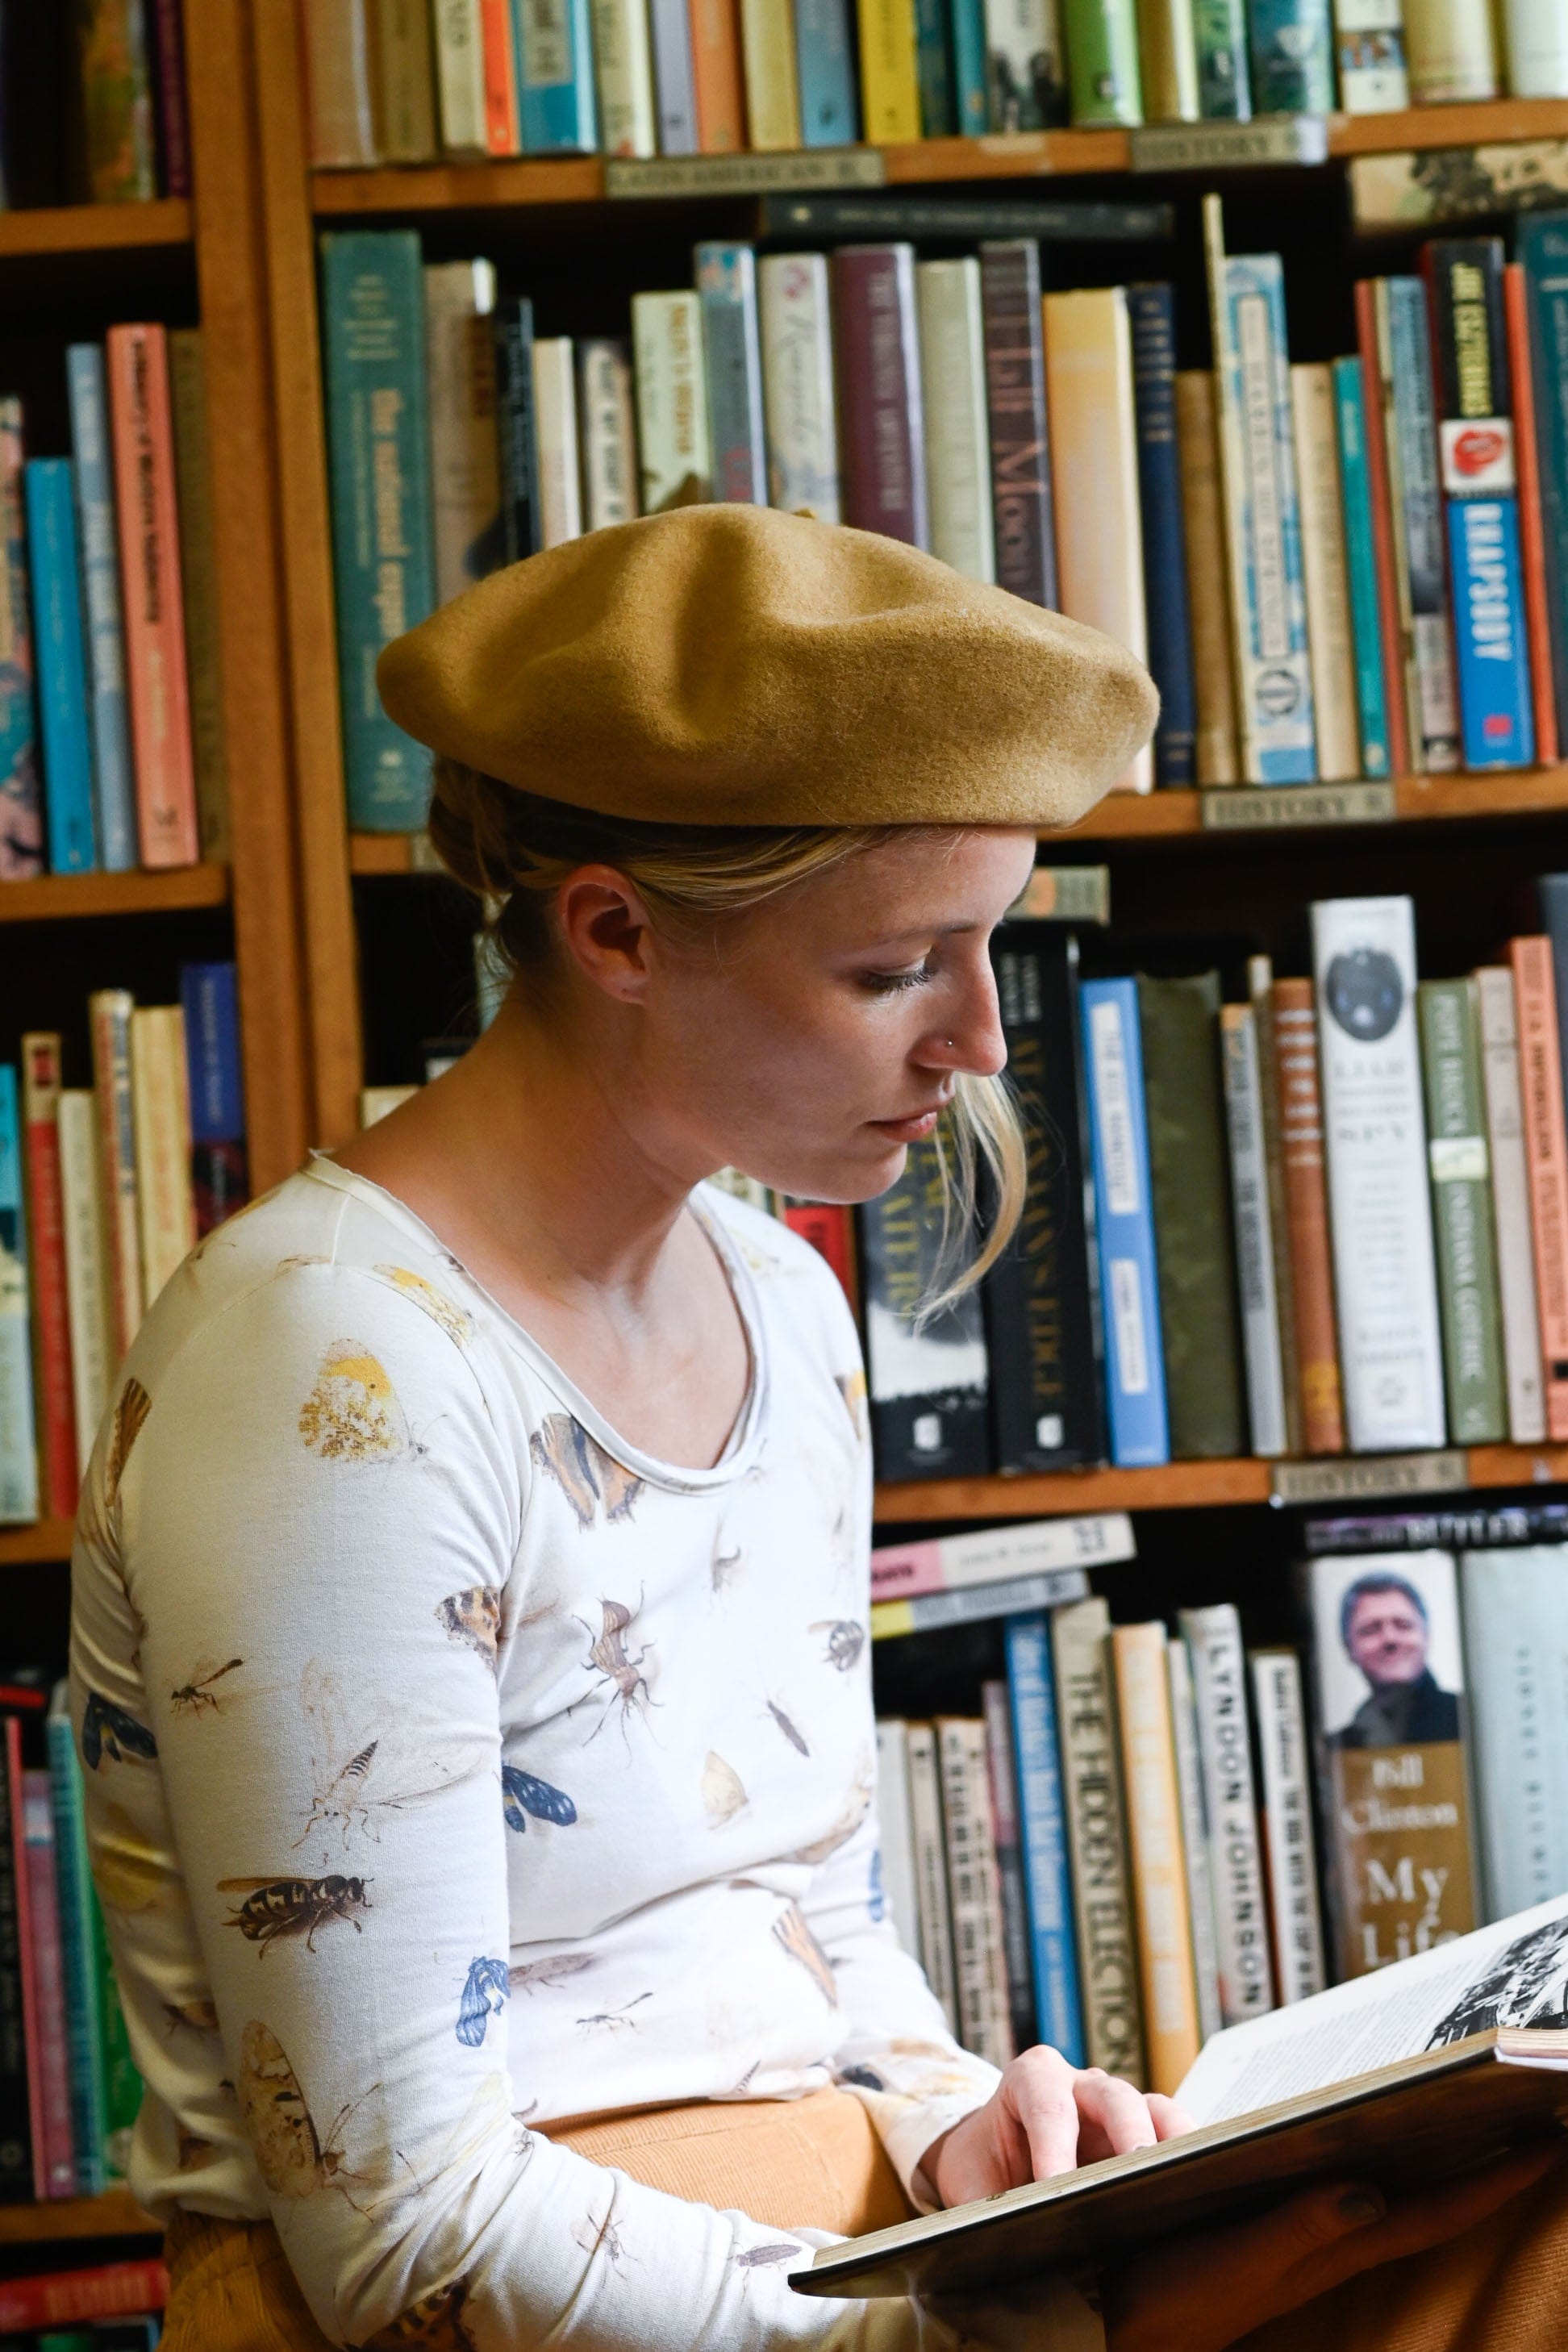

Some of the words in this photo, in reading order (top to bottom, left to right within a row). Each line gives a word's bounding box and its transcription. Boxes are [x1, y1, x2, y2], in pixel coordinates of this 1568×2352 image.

[1463, 503, 1513, 661] RHAPSODY
[1069, 1671, 1107, 1740] THE
[1209, 1645, 1244, 1803] LYNDON
[1372, 1753, 1424, 1789] Bill
[1078, 1753, 1124, 1890] HIDDEN
[1341, 1795, 1459, 1835] Clinton
[1224, 1819, 1263, 2005] JOHNSON
[1367, 1855, 1449, 1927] My
[1088, 1901, 1141, 2076] ELECTION
